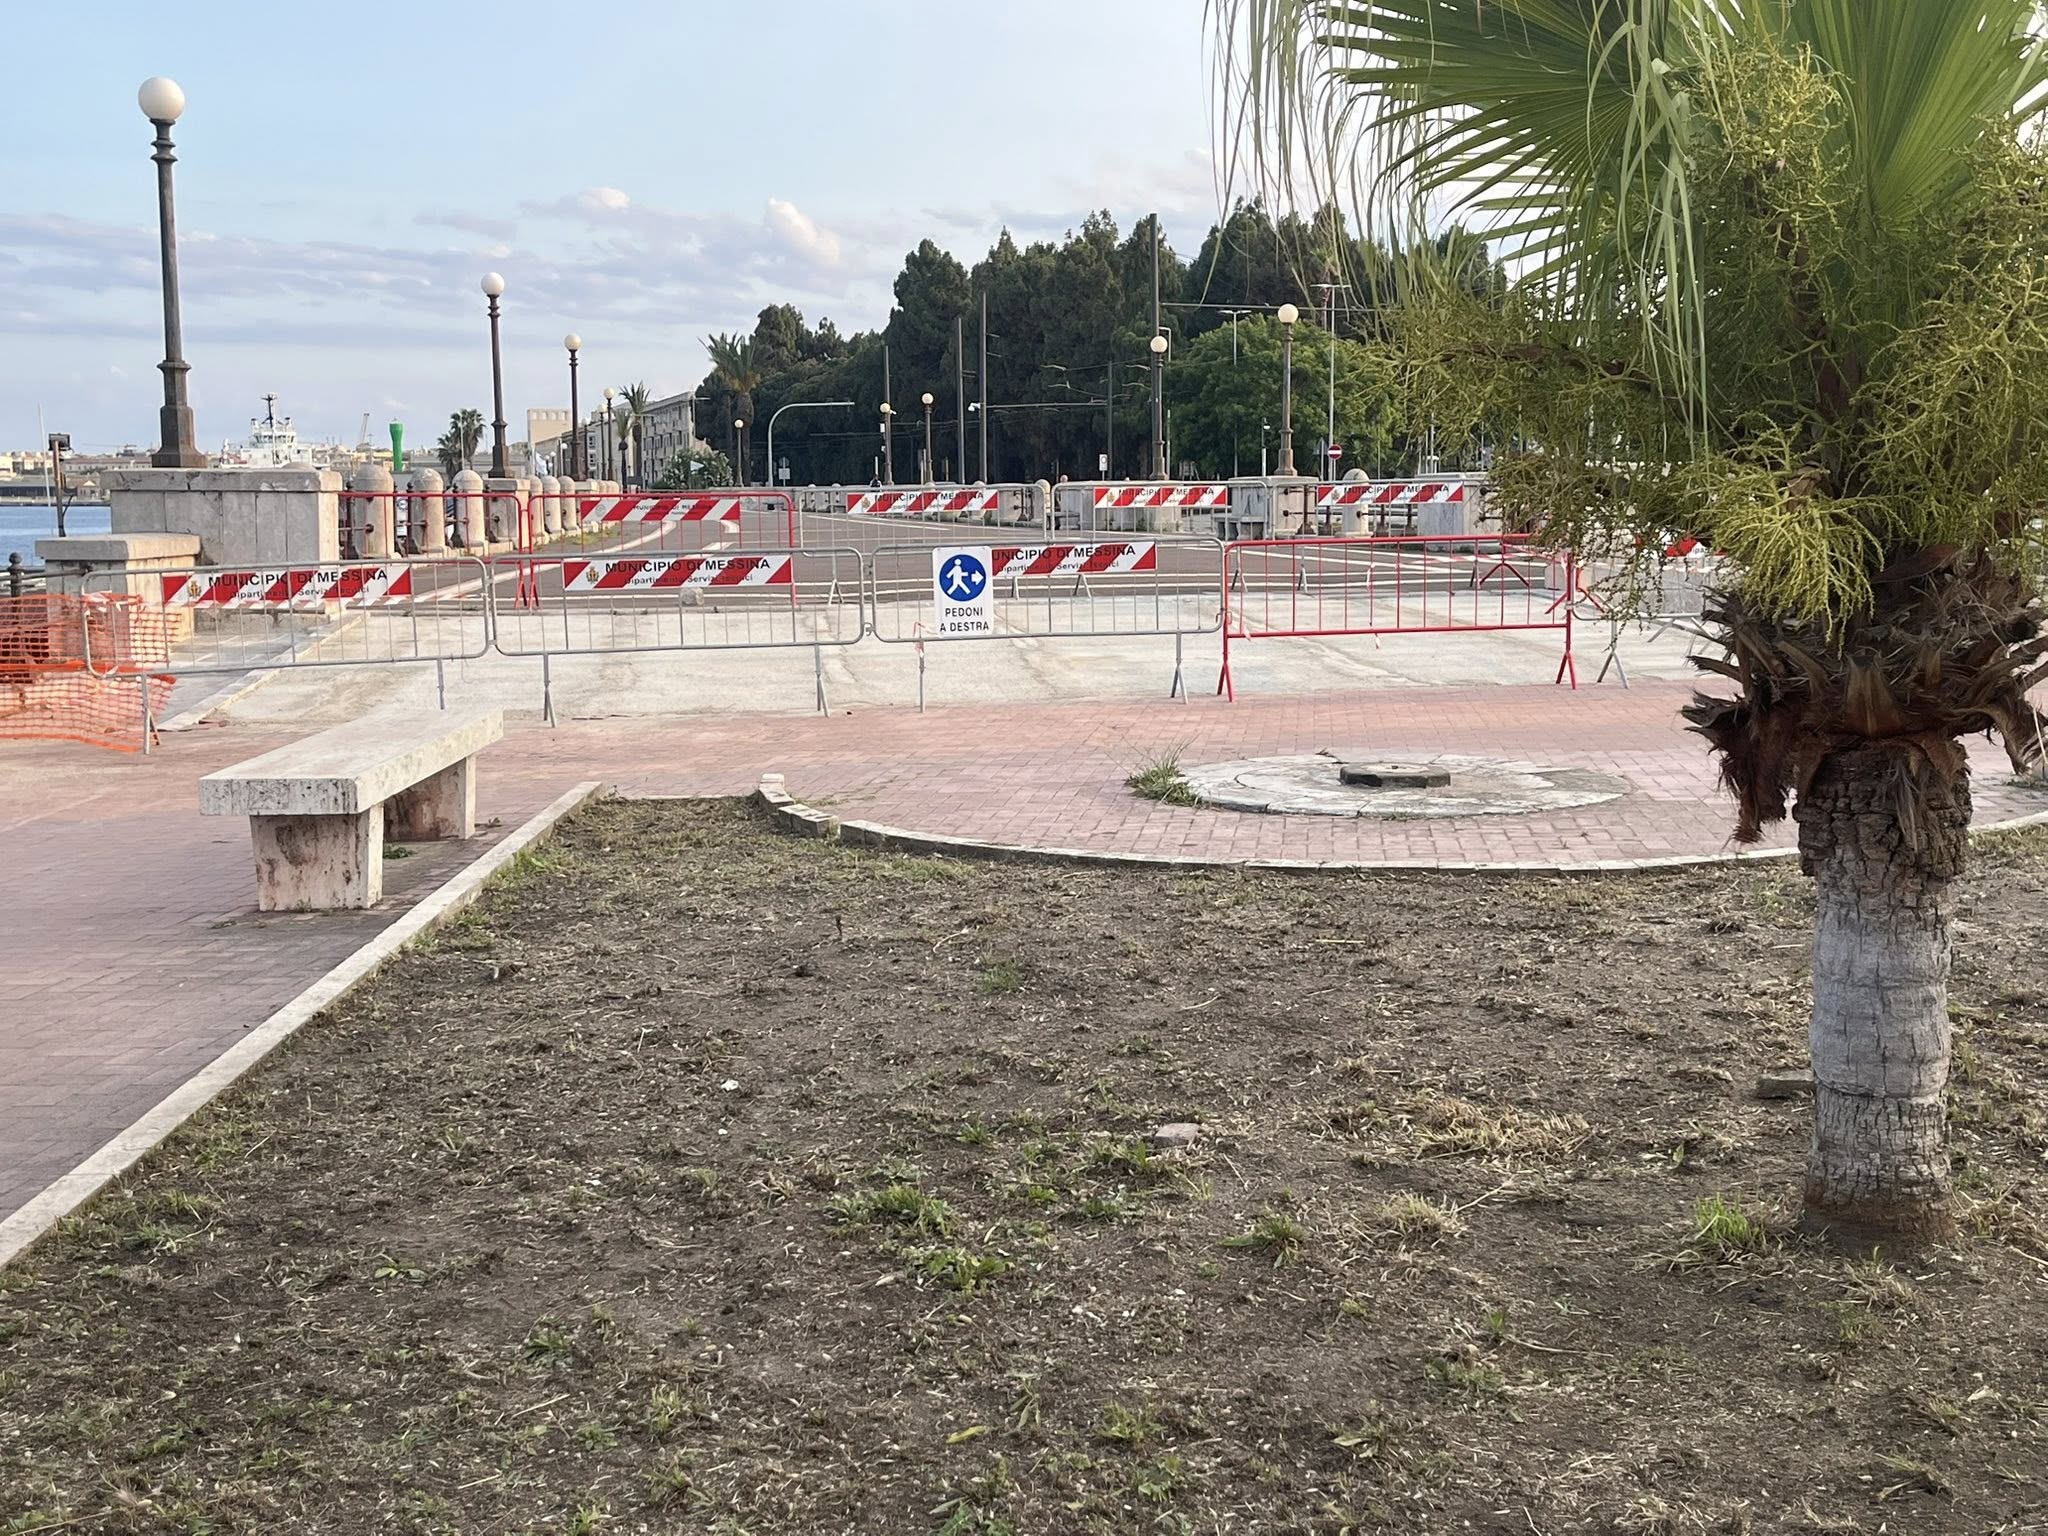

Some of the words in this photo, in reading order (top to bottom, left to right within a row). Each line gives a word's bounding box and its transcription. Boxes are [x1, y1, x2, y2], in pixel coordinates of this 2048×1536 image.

[993, 548, 1052, 560] UNICIPIO
[1057, 548, 1070, 558] DI
[1074, 546, 1136, 557] MESSINA
[605, 561, 681, 573] MUNICIPIO
[687, 561, 700, 570] DI
[705, 559, 770, 570] MESSINA
[298, 572, 312, 583] DI
[317, 569, 388, 583] MESSNA
[945, 607, 983, 617] PEDONI
[940, 623, 946, 632] A
[950, 621, 989, 632] DESTRA
